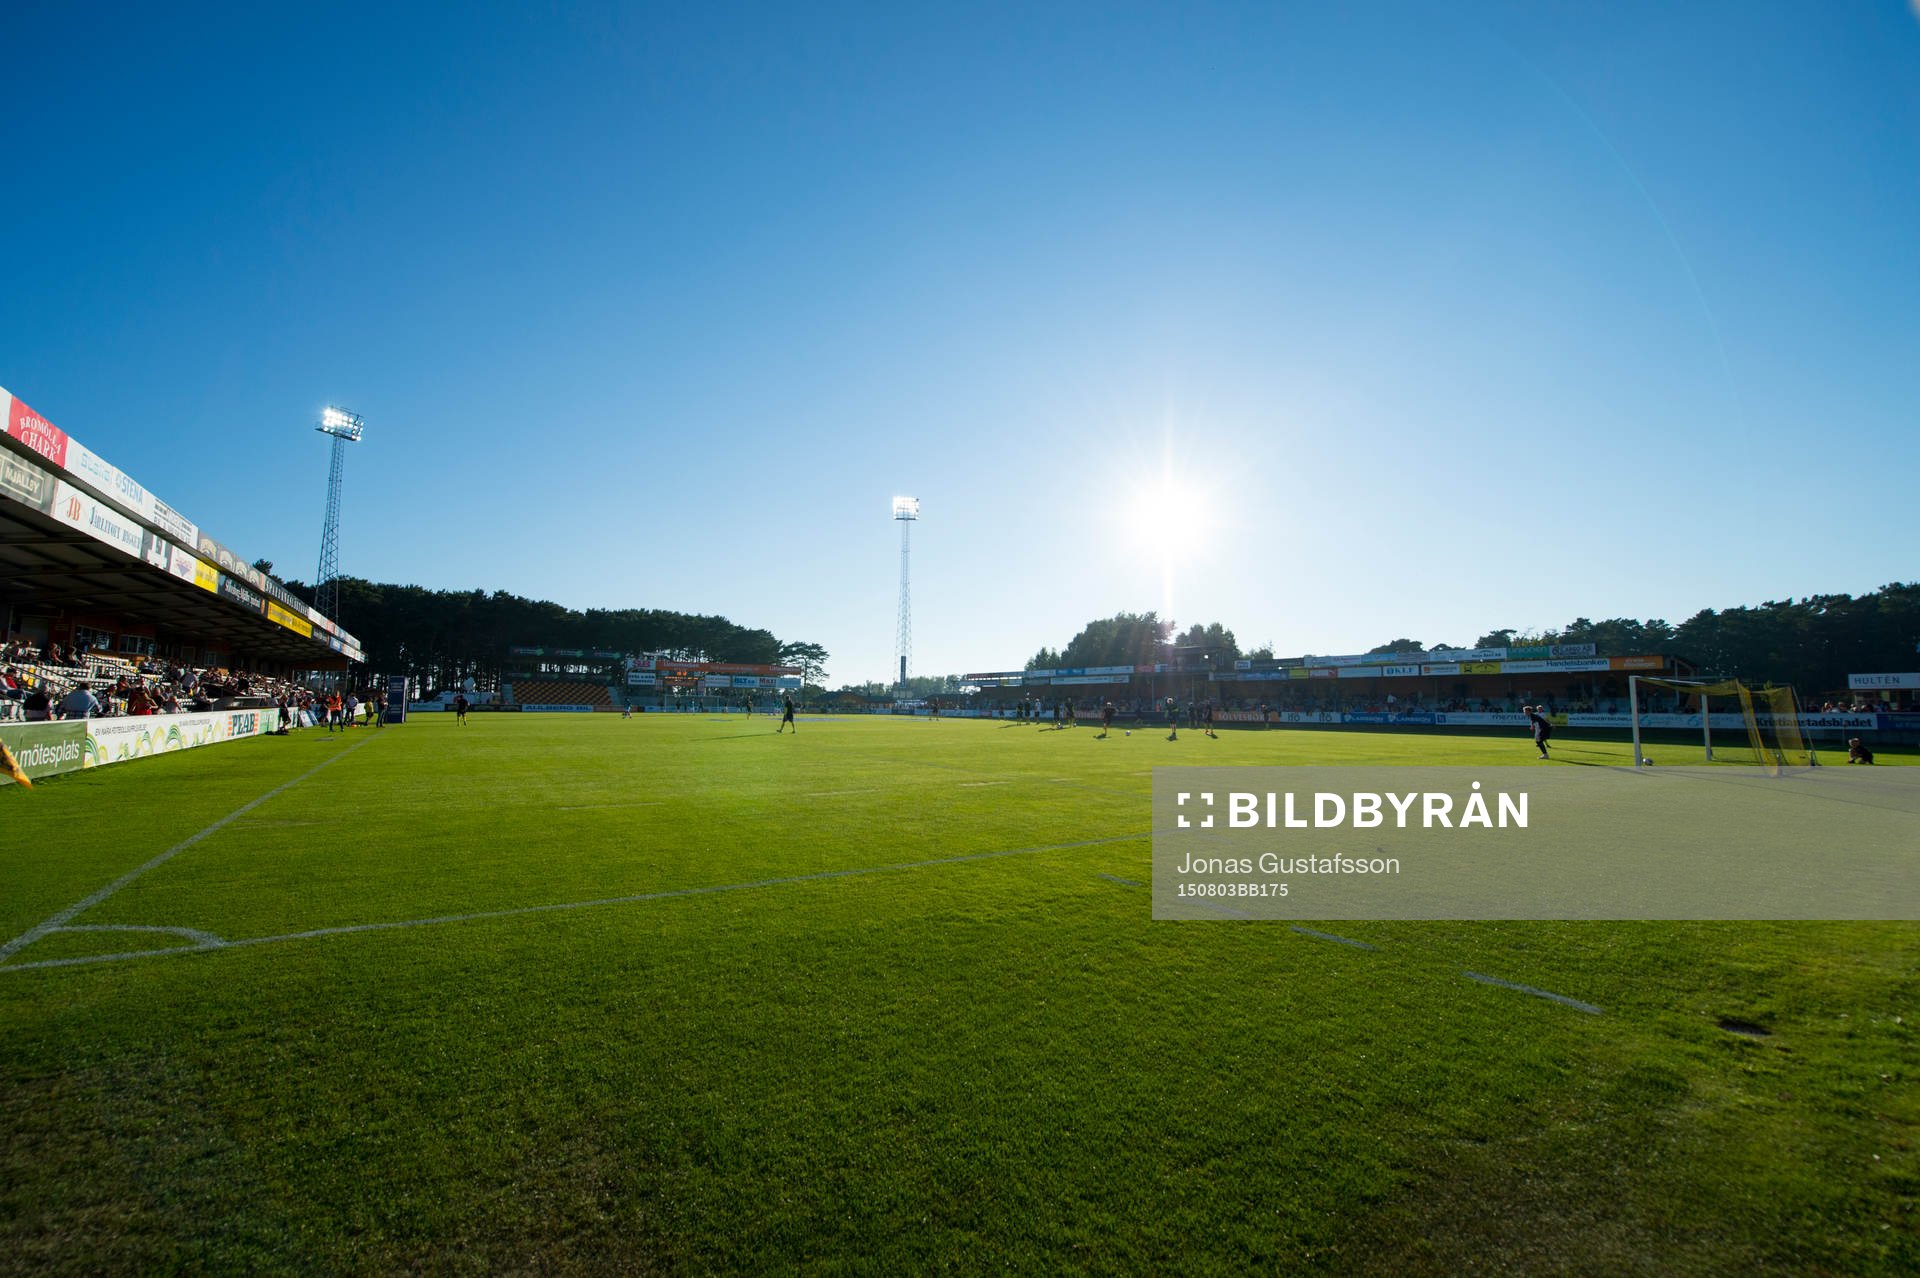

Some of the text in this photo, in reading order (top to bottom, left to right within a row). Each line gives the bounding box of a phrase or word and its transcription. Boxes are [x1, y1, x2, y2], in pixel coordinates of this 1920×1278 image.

[21, 430, 56, 463] CHARK
[1546, 659, 1608, 667] Handelsbanken
[1854, 675, 1901, 685] HULTÉN
[231, 713, 255, 737] PEAB
[20, 739, 80, 768] mötesplats
